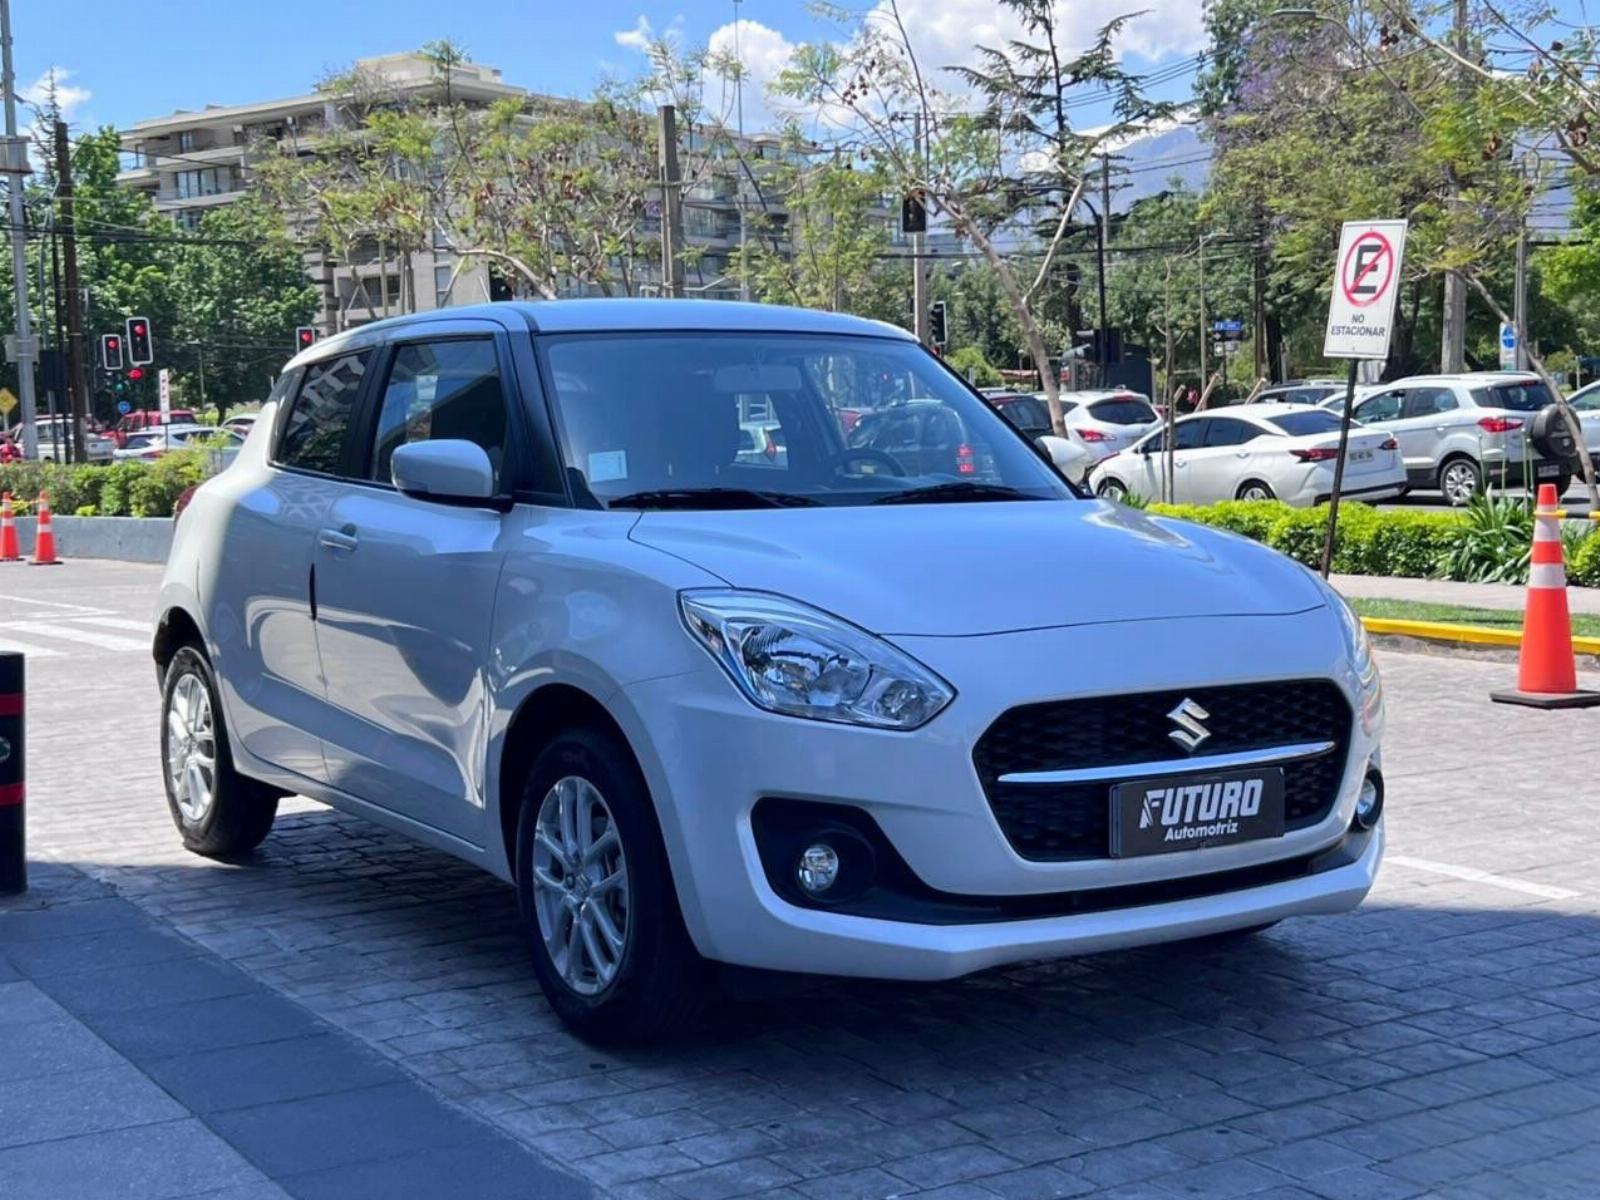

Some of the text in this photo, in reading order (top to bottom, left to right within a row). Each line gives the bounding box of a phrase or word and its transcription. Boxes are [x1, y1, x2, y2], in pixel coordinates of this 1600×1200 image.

[1351, 314, 1364, 323] NO
[1331, 326, 1385, 337] ESTACIONAR
[1139, 779, 1264, 829] FUTURO
[1164, 820, 1239, 842] Automotriz
